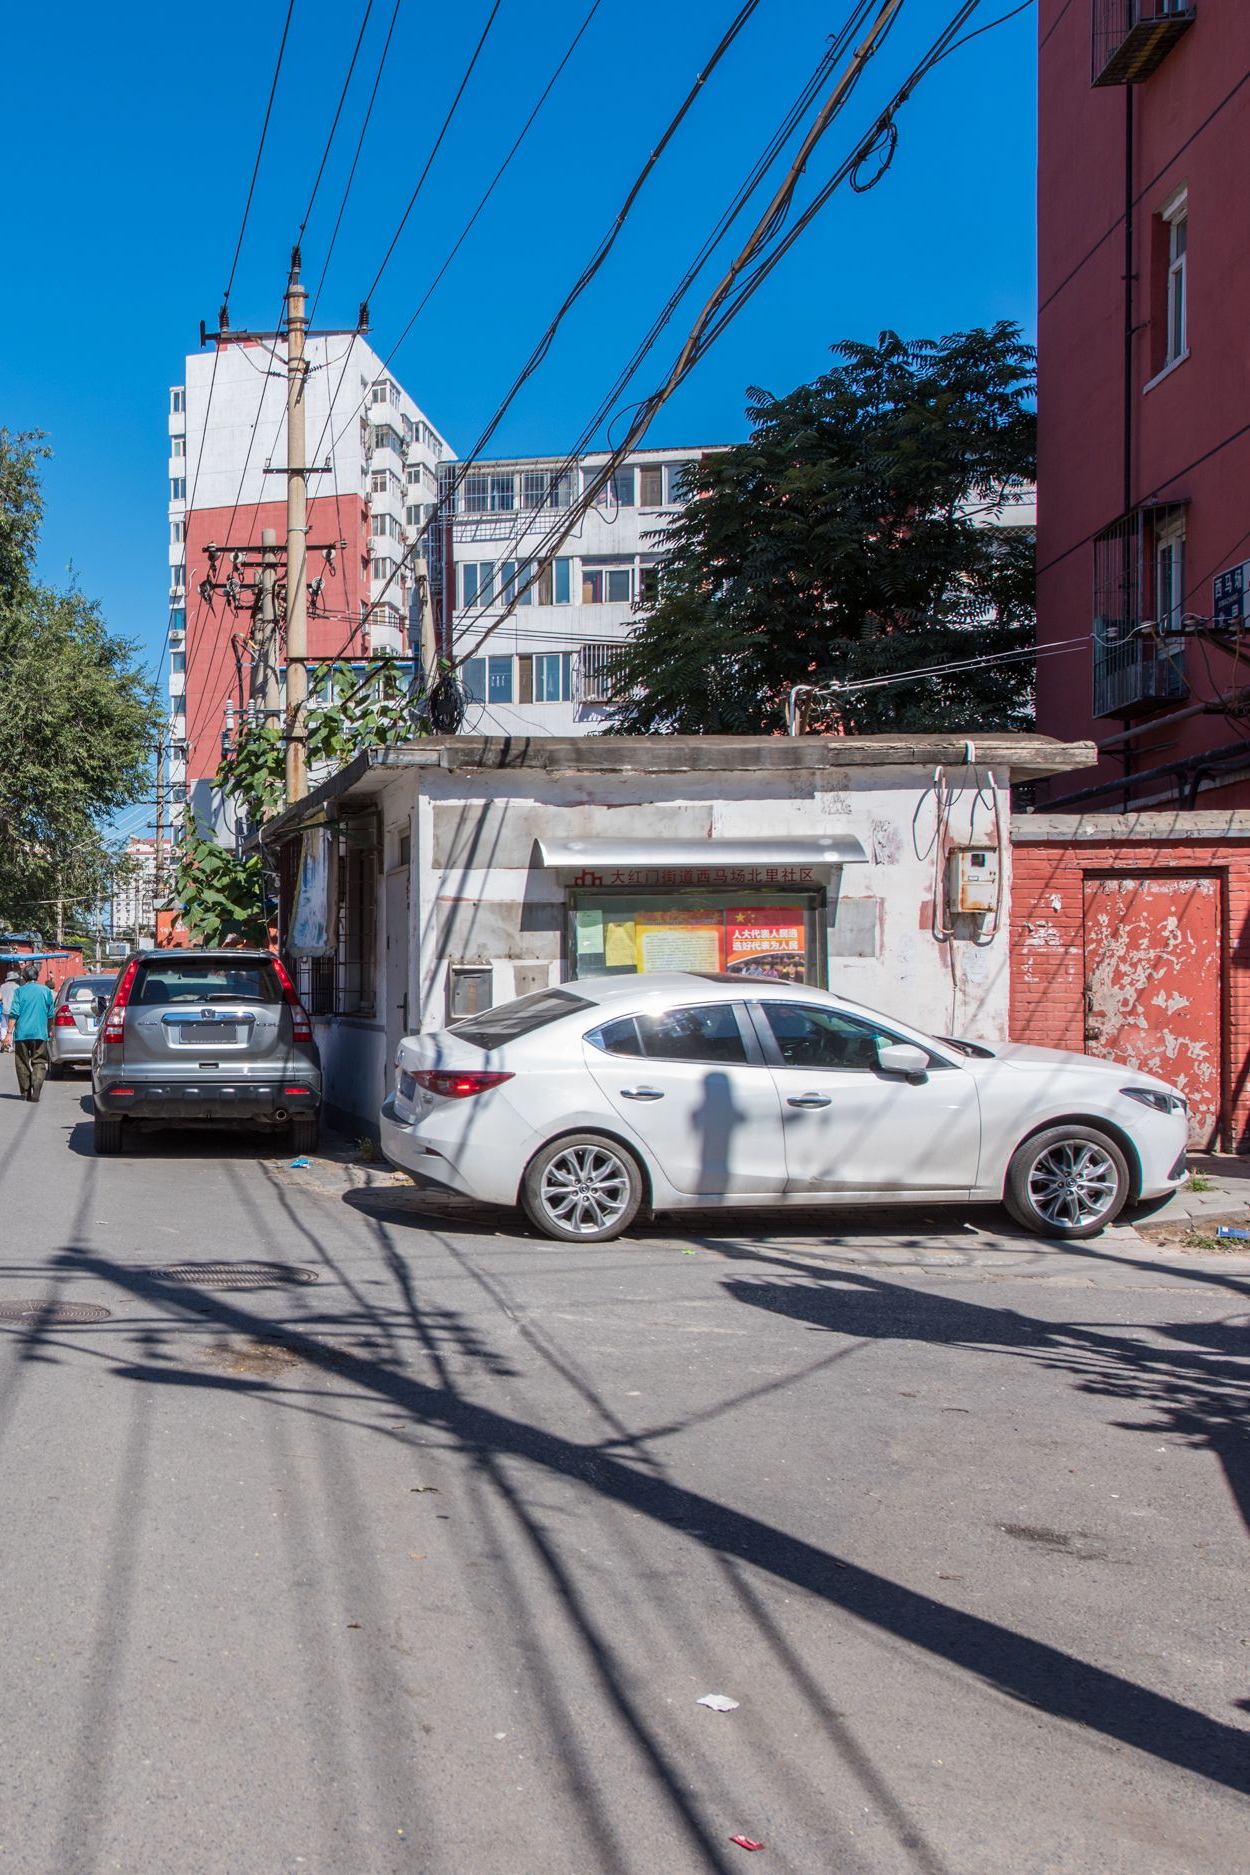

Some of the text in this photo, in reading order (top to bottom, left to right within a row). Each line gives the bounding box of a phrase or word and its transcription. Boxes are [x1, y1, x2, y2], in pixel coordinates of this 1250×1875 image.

[610, 868, 815, 885] 大红门街道西马场北里社区
